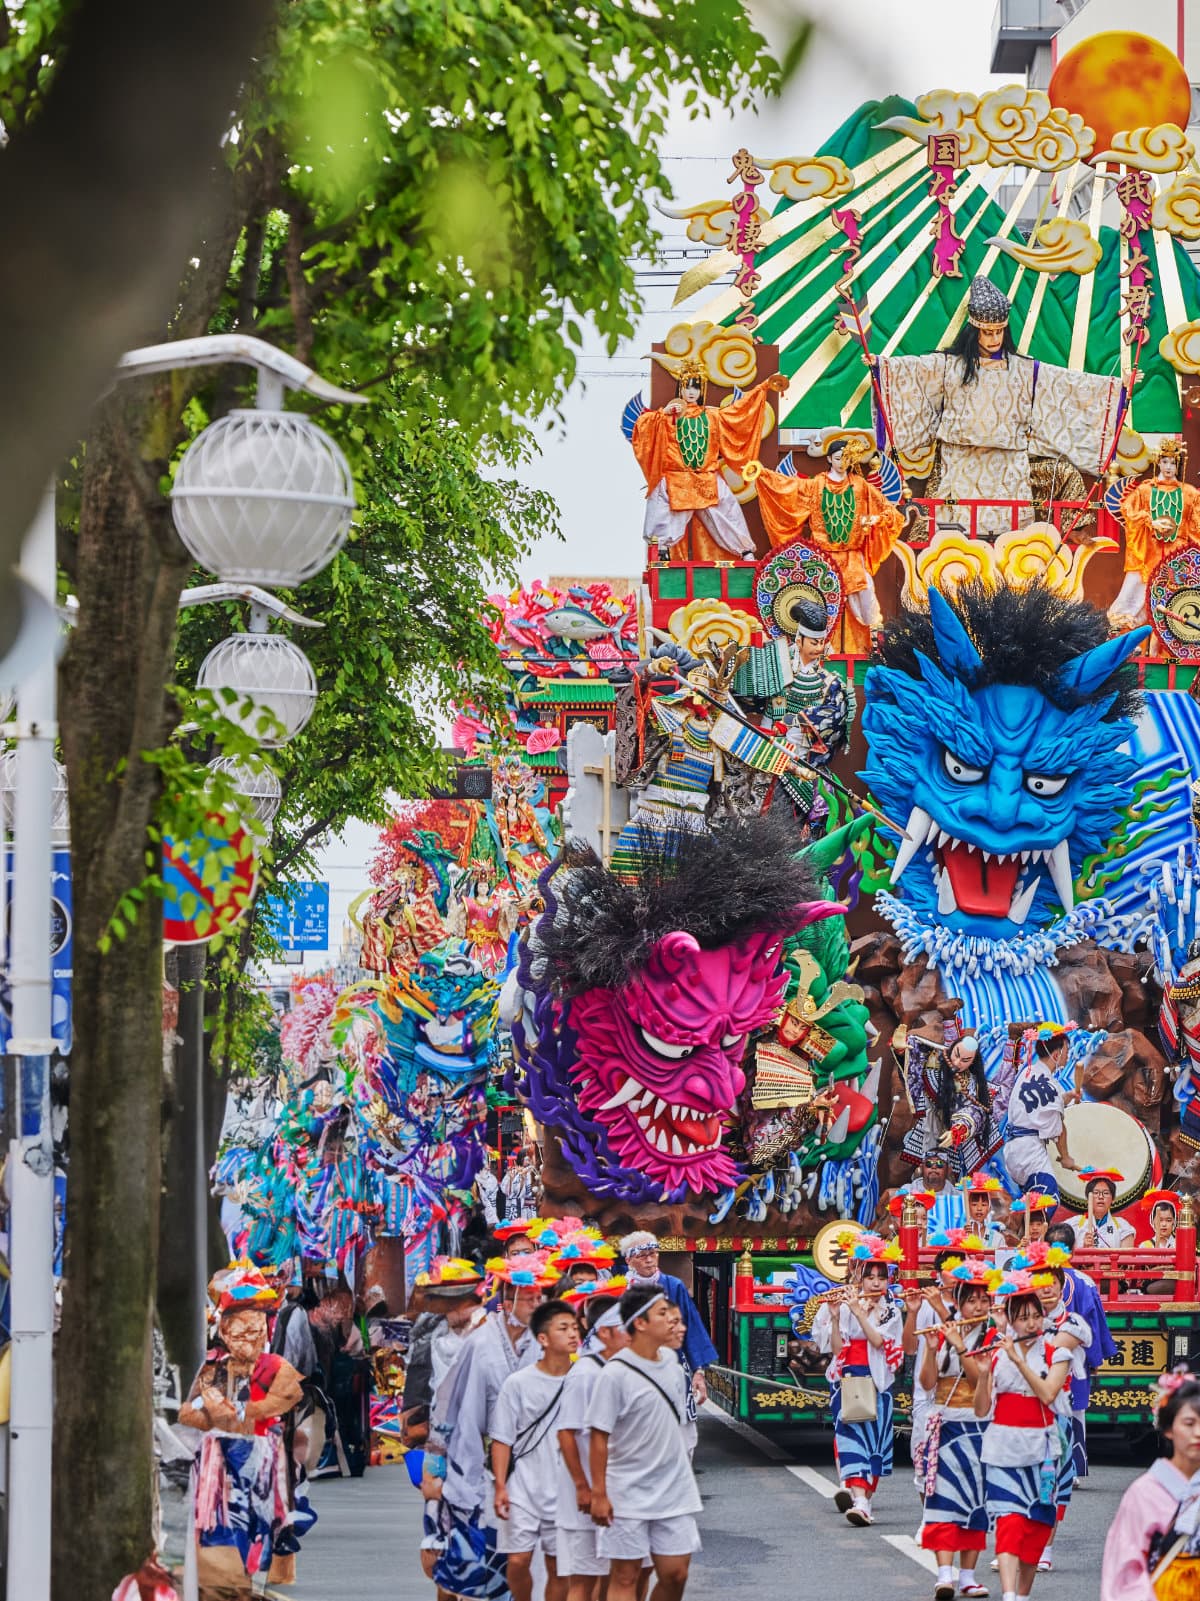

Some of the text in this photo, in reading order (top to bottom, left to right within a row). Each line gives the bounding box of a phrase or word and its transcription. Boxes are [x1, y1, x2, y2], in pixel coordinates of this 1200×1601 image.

[726, 147, 768, 344] 鬼の棲なる
[927, 133, 966, 278] 国なれば
[1115, 172, 1156, 347] 我が大君の
